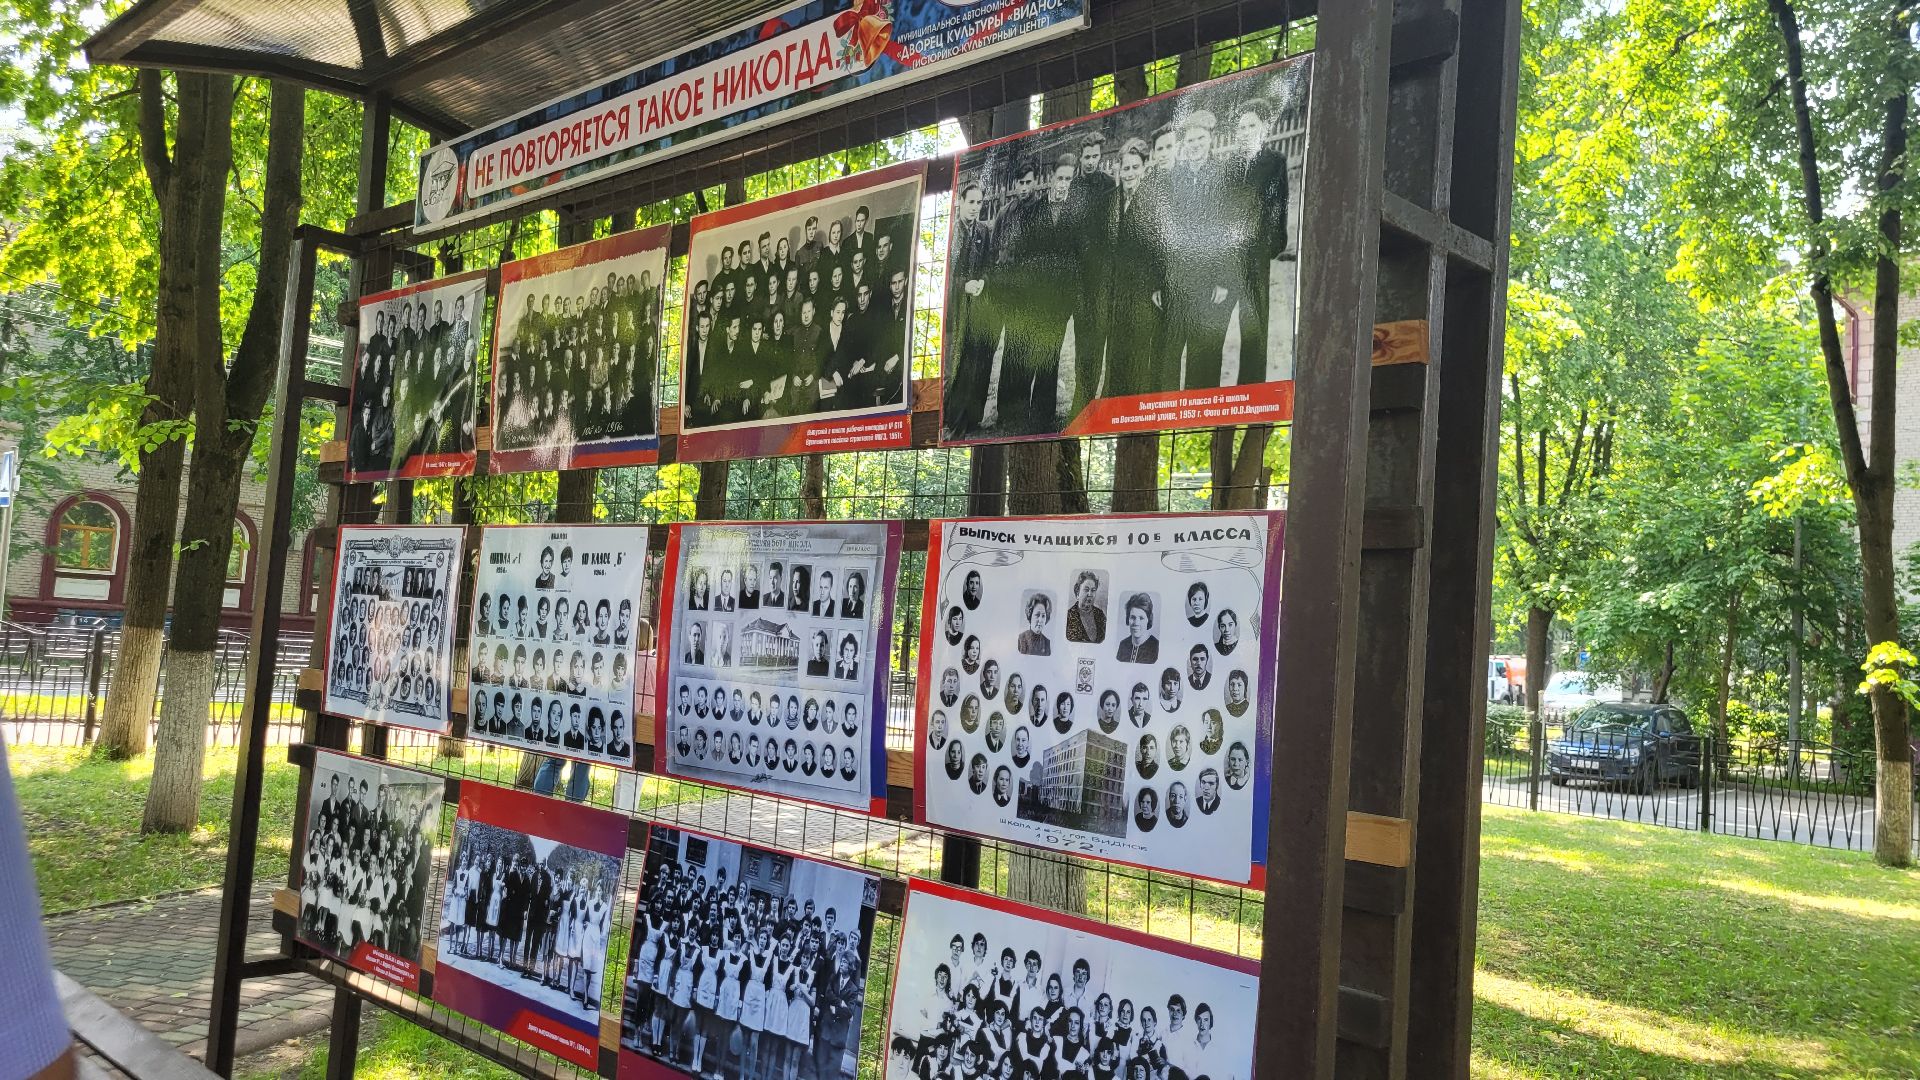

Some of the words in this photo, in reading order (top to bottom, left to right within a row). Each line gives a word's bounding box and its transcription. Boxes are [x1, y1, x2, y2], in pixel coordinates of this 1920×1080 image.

[897, 15, 960, 44] МУНИЦИПАЛЬНОЕ
[897, 32, 944, 61] «ДВОРЕЦ
[946, 13, 1004, 44] КУЛЬТУРЫ
[912, 25, 1017, 70] (ИСТОРИКО-КУЛЬТУРНЫЙ
[1020, 15, 1050, 35] ЦЕНТР)
[474, 153, 494, 190] НЕ
[500, 104, 631, 178] ПОВТОРЯЕТСЯ
[638, 77, 705, 135] ТАКОЕ
[1139, 400, 1177, 411] Выпускники
[1179, 398, 1187, 407] 10
[1188, 396, 1211, 406] класса
[1225, 394, 1249, 403] школы
[1120, 413, 1156, 424] Вокзальной
[1204, 408, 1220, 417] Фото
[1222, 408, 1229, 416] от
[959, 526, 1016, 544] ВЫПУСК
[1024, 532, 1118, 547] УЧАЩИХСЯ
[1174, 527, 1251, 542] КЛАССА
[1077, 683, 1092, 693] 50
[999, 818, 1031, 830] ШКОЛА
